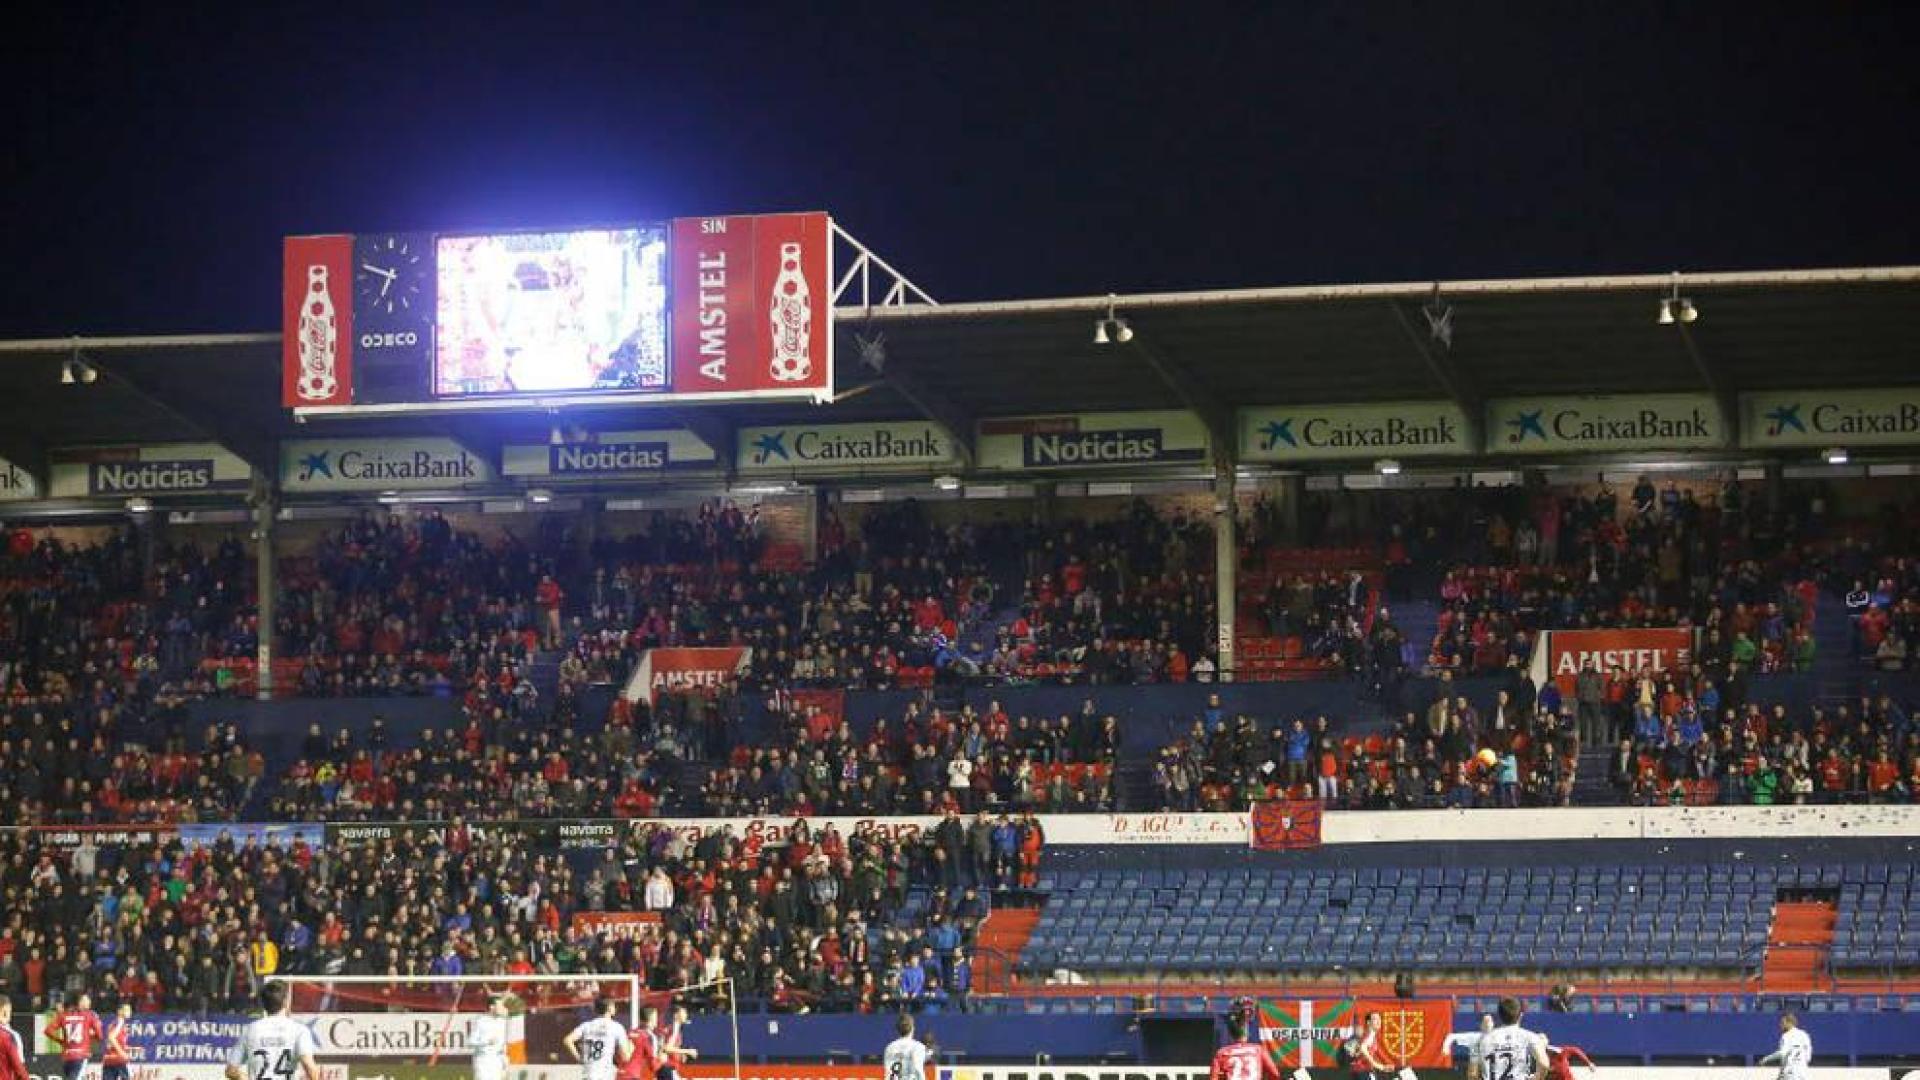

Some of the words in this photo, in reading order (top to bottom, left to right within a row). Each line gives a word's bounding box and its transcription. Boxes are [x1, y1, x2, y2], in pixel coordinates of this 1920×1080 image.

[702, 220, 726, 233] SIN
[700, 251, 727, 382] AMSTEL
[1303, 416, 1457, 447] CaixaBank
[1553, 407, 1710, 441] CaixaBank
[558, 445, 664, 470] Noticias
[794, 429, 940, 460] CaixaBank
[1032, 431, 1157, 463] Noticias
[98, 462, 209, 491] Noticias
[339, 451, 476, 480] CaixaBank
[1557, 649, 1667, 675] AMSTEL
[65, 1022, 83, 1044] 14
[253, 1048, 293, 1080] 24
